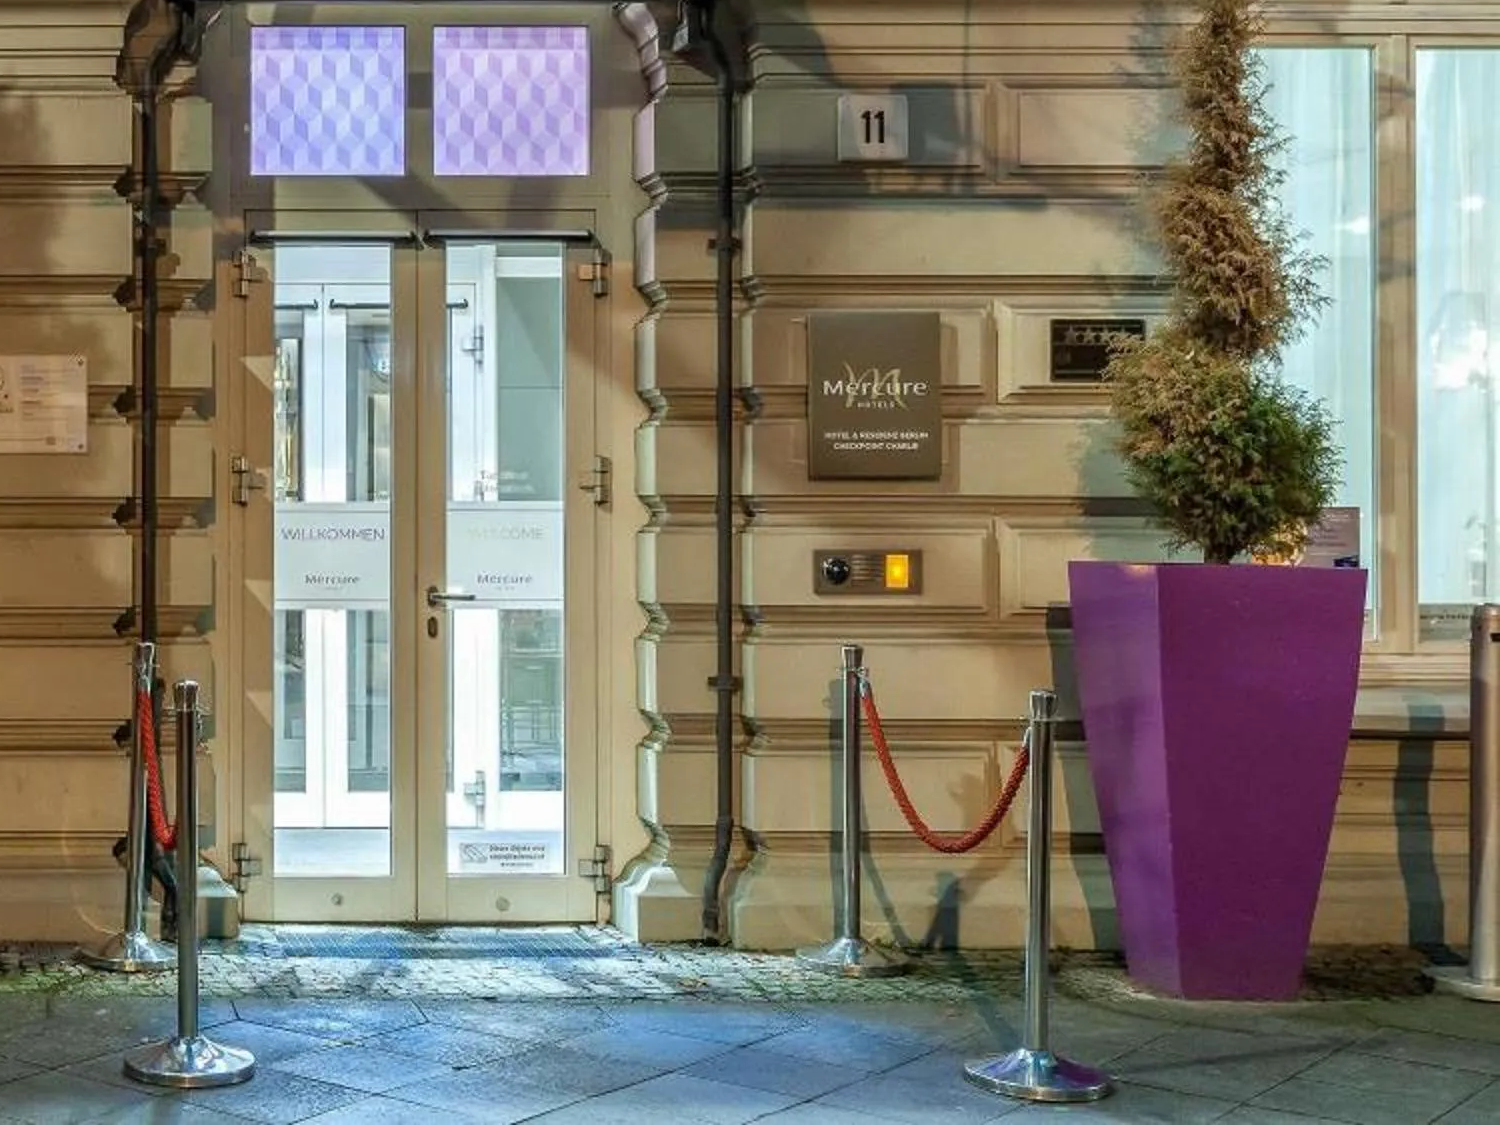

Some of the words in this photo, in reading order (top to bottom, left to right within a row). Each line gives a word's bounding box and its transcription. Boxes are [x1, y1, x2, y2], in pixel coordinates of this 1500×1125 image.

[860, 109, 885, 144] 11
[823, 379, 928, 397] Mercure
[280, 527, 386, 541] WILLKOMMEN
[304, 573, 361, 585] Mercure
[476, 573, 534, 585] Mercure
